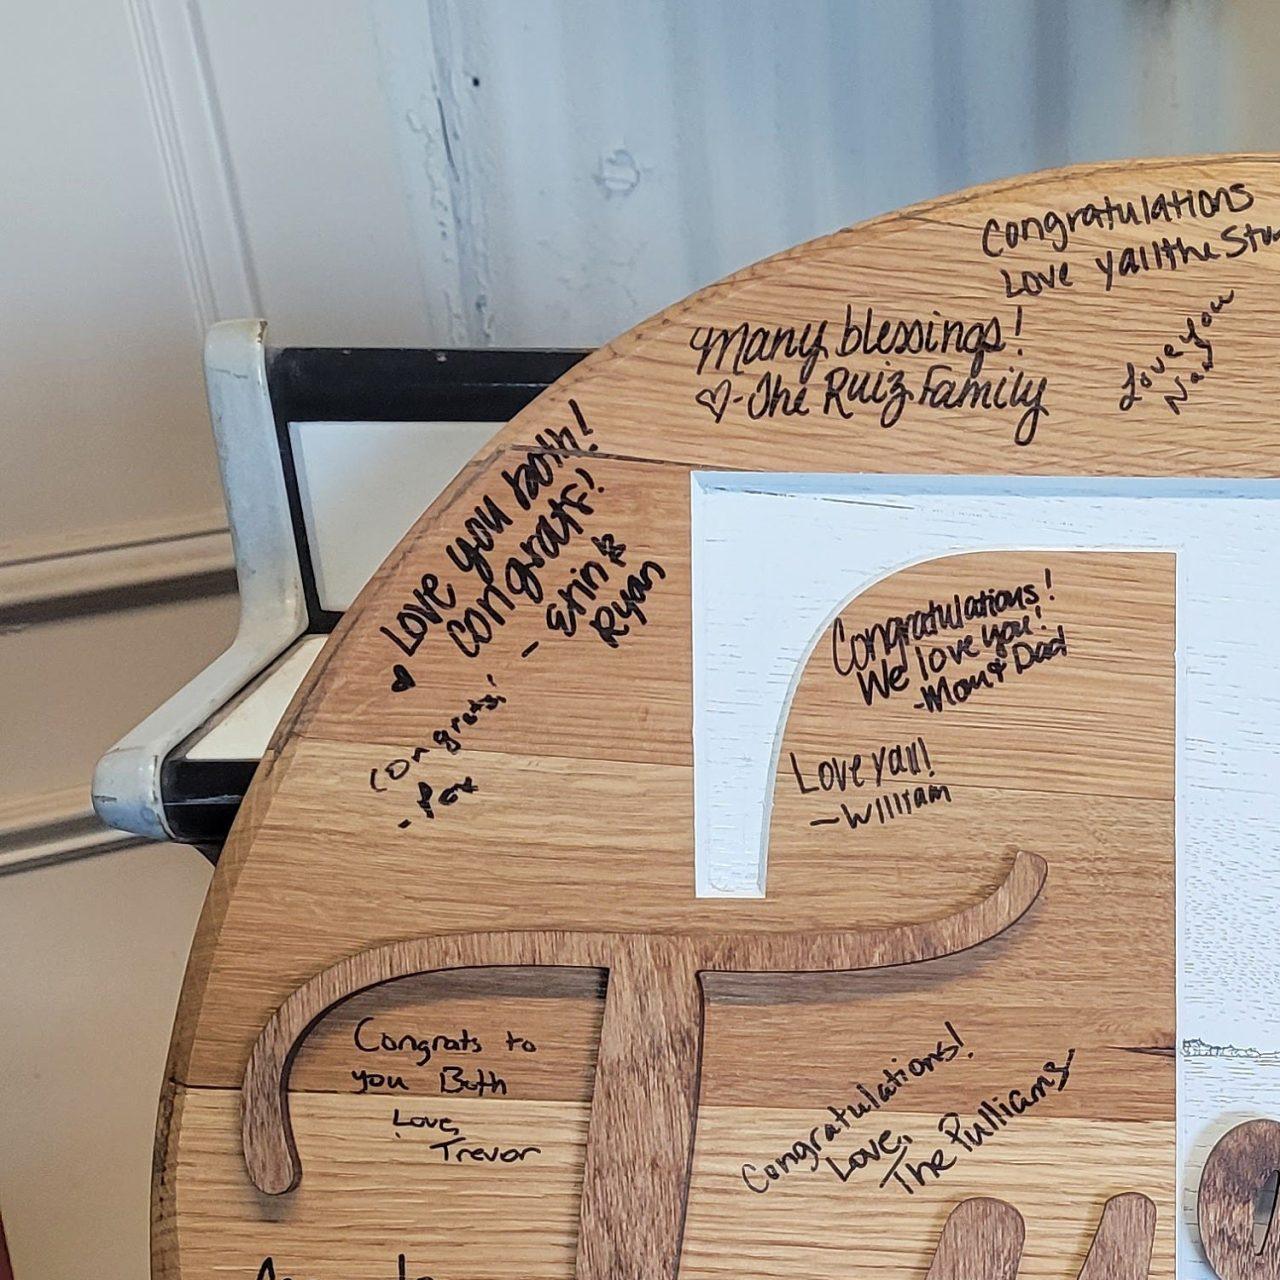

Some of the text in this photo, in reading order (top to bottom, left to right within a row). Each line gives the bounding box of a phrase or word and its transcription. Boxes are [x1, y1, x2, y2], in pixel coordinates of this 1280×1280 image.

[982, 183, 1255, 257] Congratulations
[1000, 262, 1073, 297] Love
[689, 303, 1024, 384] Many blessings!
[823, 361, 914, 428] Ruiz
[918, 364, 1050, 446] Family
[446, 495, 514, 584] you
[501, 399, 599, 510] both!
[589, 561, 666, 648] Ryan
[832, 568, 1055, 677] Congratulations!
[857, 659, 910, 706] We
[915, 635, 980, 681] love
[1012, 625, 1068, 674] Dad
[790, 752, 865, 794] Love
[354, 1017, 537, 1066] Congrats to
[351, 1066, 507, 1096] you Both
[742, 1021, 975, 1193] Congratulations!
[430, 1137, 541, 1162] Trevor
[880, 1146, 957, 1195] The
